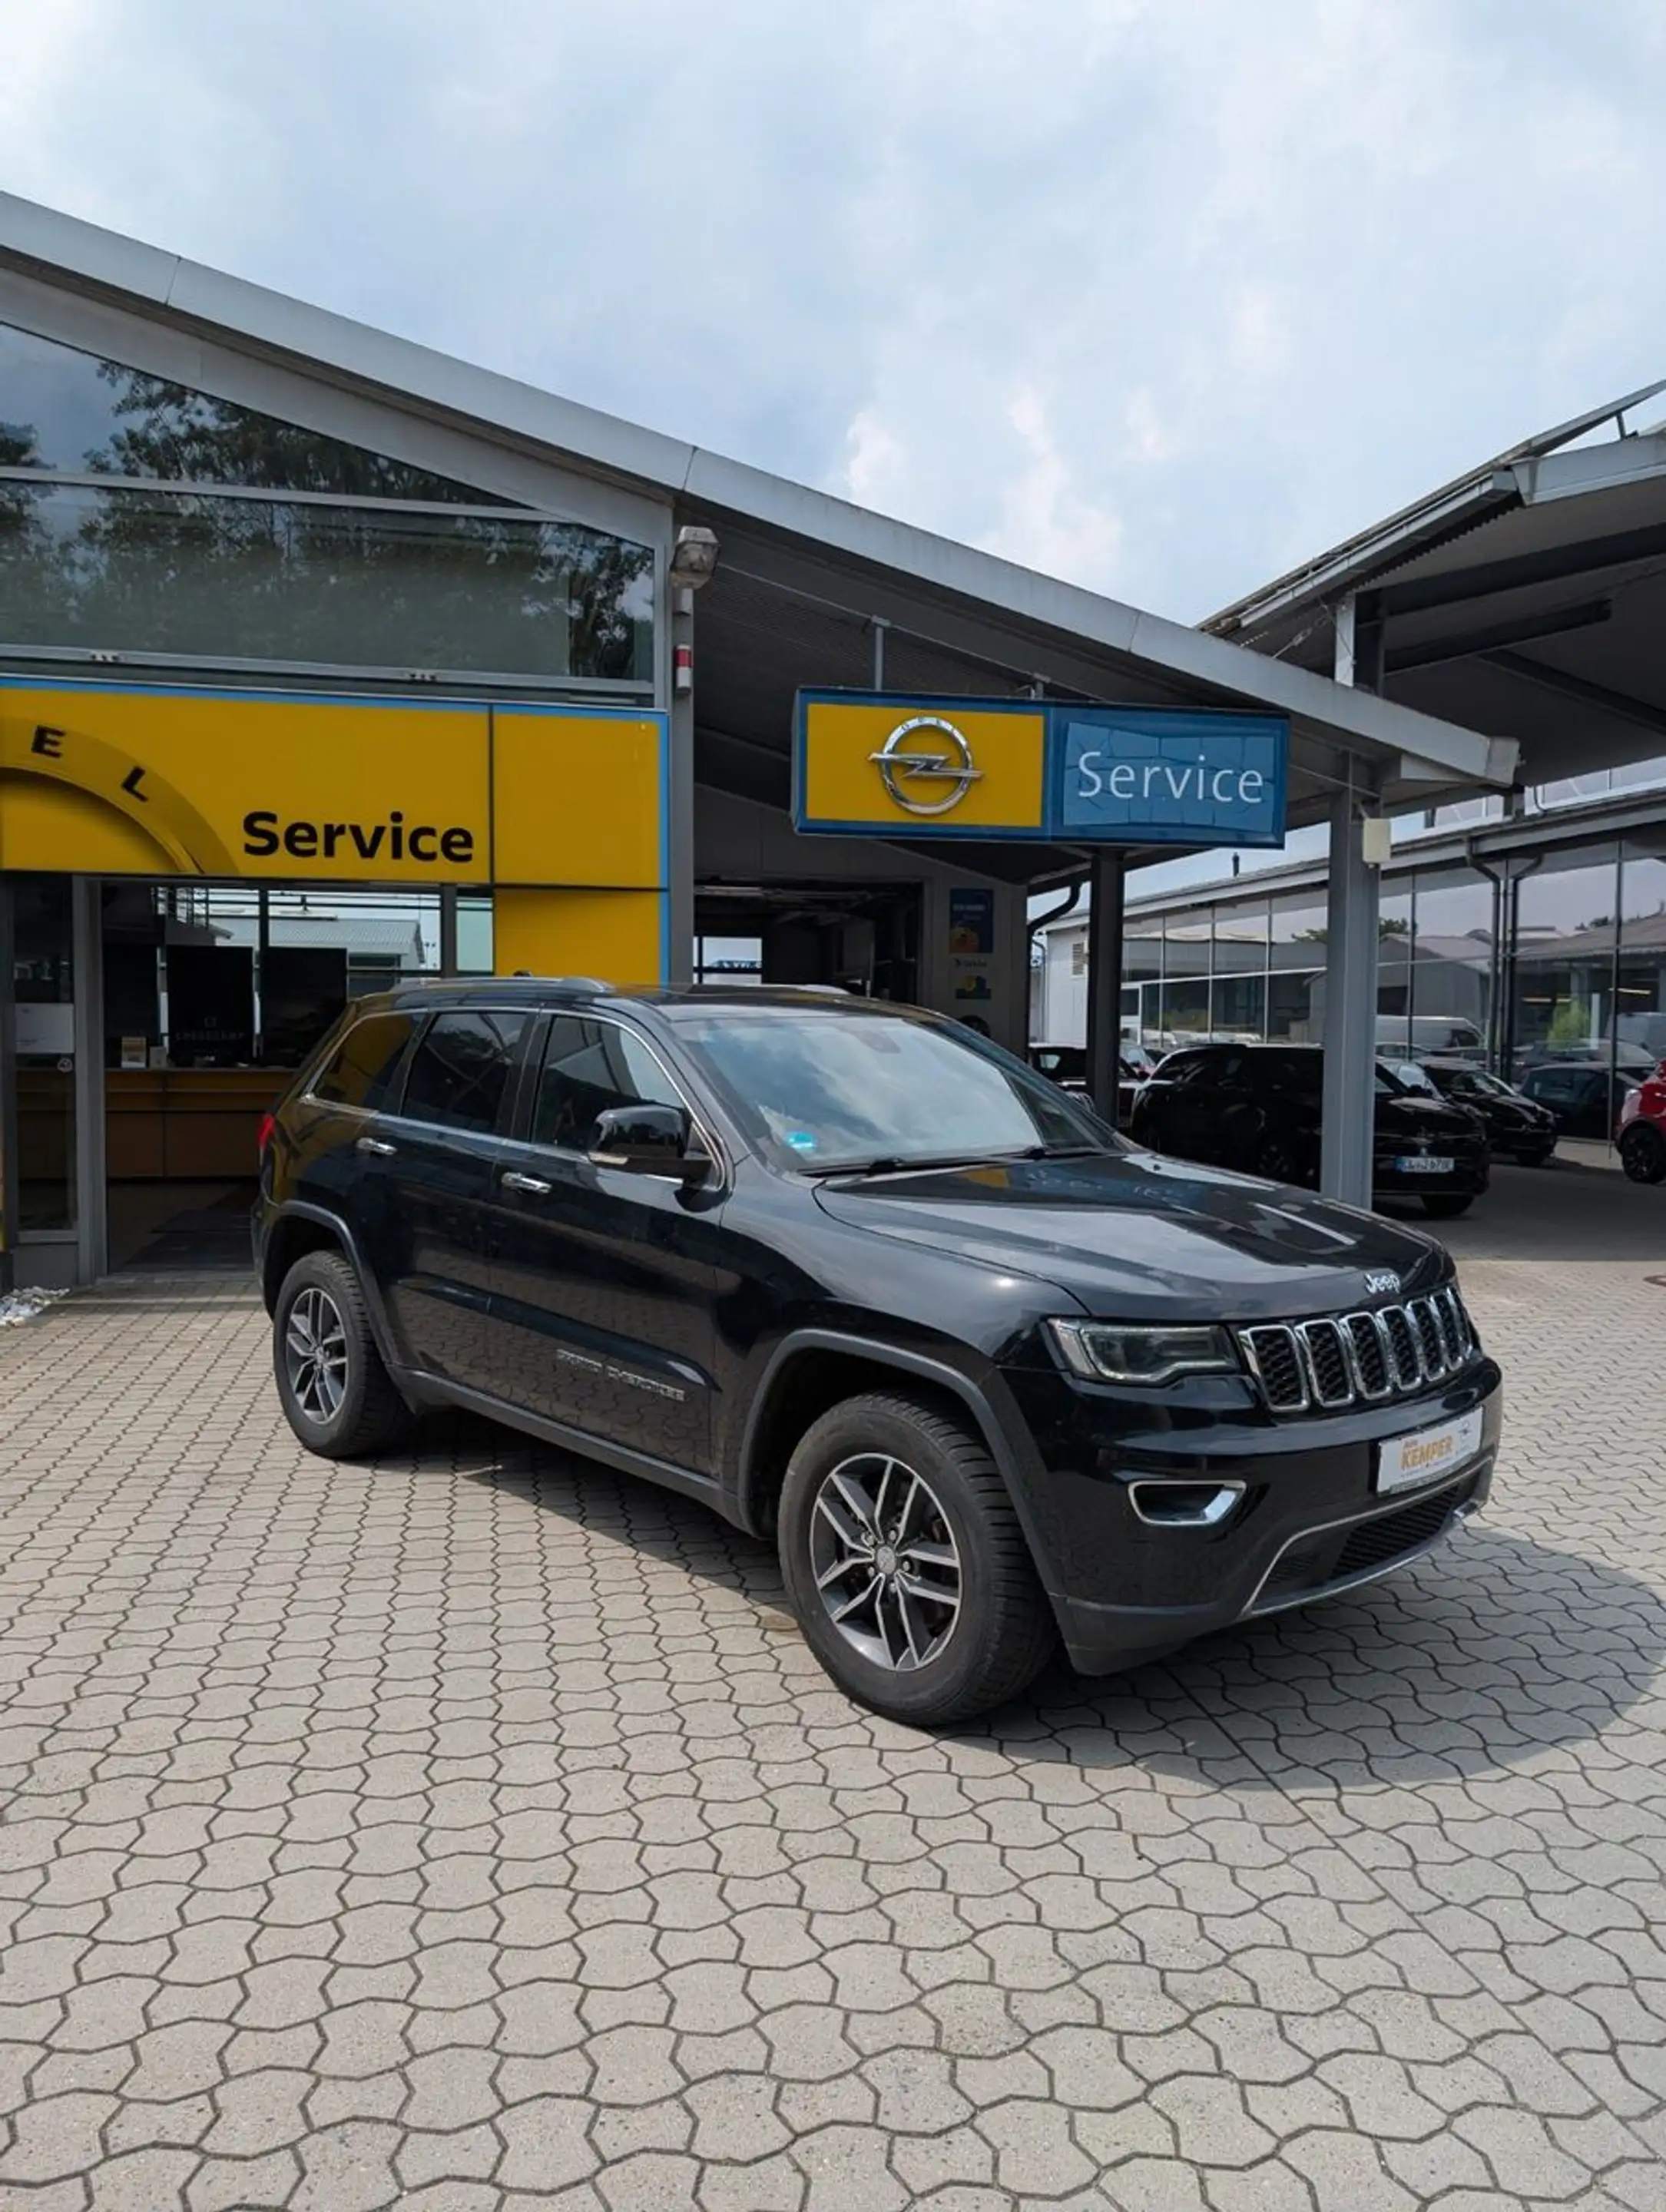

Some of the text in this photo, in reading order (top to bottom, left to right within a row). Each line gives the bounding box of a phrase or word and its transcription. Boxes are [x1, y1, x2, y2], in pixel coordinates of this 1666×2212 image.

[1078, 751, 1264, 803] Service
[243, 810, 474, 863] Service
[1364, 1273, 1400, 1294] Jeep
[1399, 1434, 1453, 1471] KEMPER
